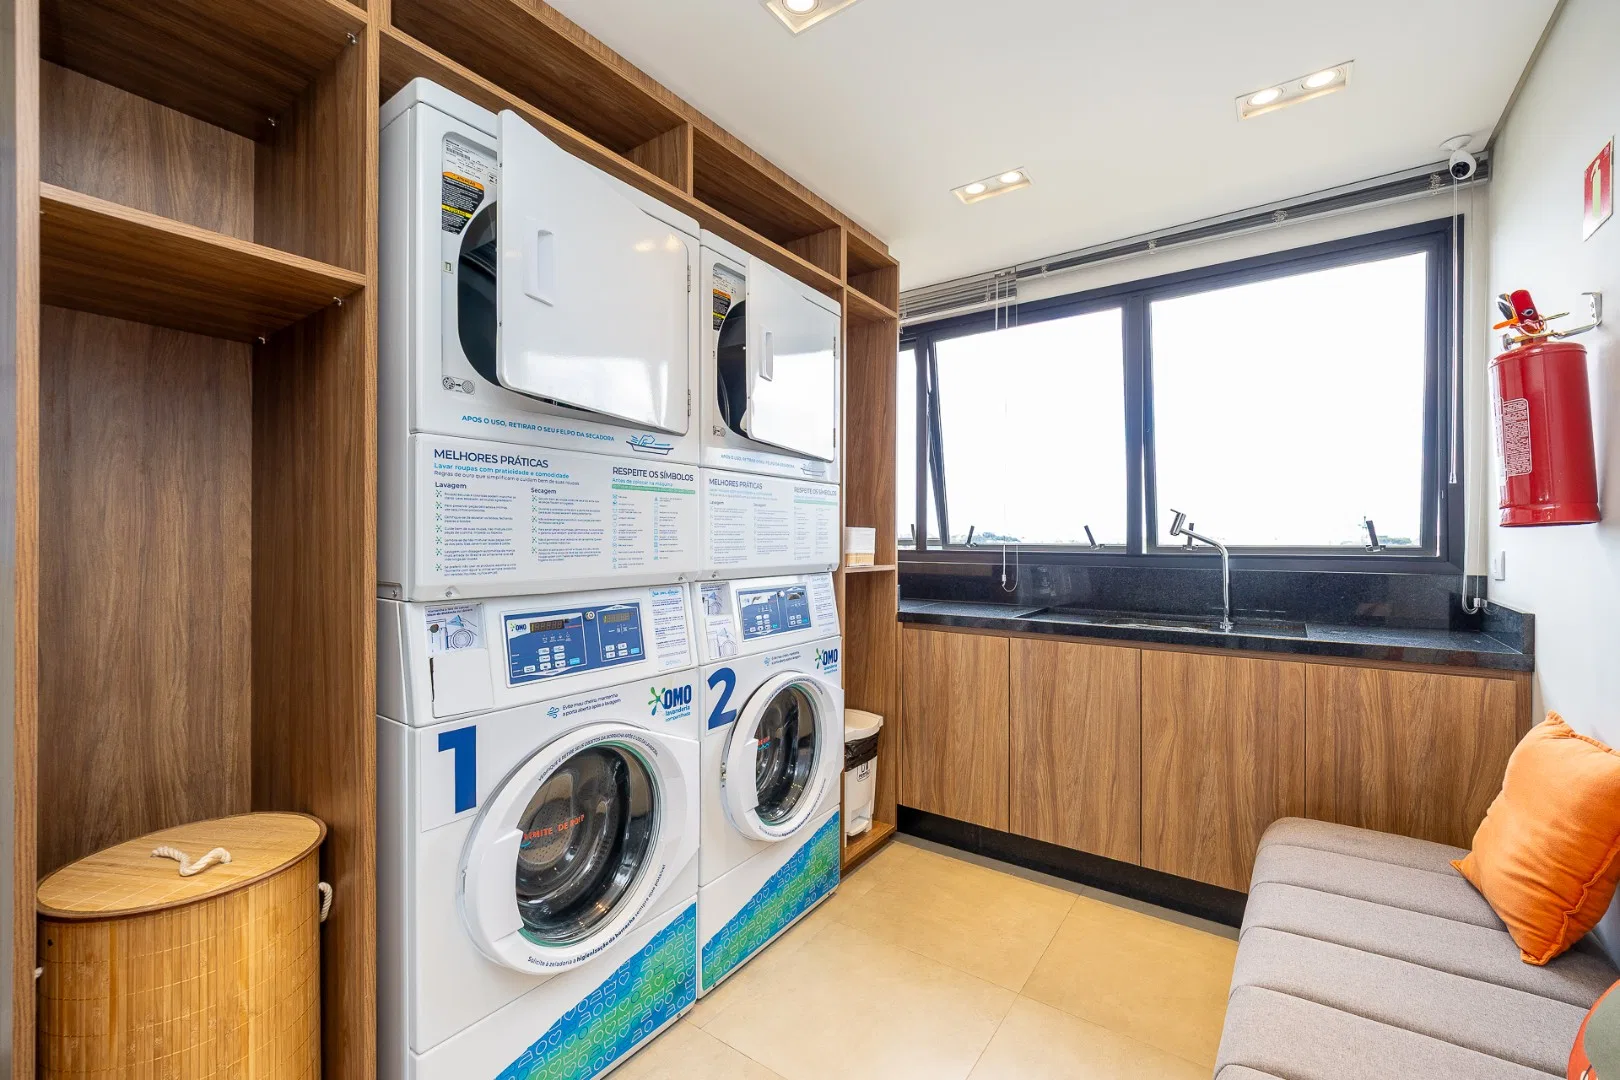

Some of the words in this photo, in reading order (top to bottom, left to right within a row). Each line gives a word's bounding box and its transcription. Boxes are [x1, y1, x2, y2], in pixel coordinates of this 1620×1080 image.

[491, 419, 507, 427] USO,
[508, 422, 536, 431] RETIRAR
[586, 432, 614, 441] SECADORA
[434, 449, 498, 463] MELHORES
[501, 455, 548, 468] PRÁTICAS
[495, 468, 529, 476] praticidade
[612, 467, 647, 478] RESPEITE
[660, 470, 694, 481] SÍMBOLOS
[709, 479, 739, 487] MELHORES
[740, 481, 762, 489] PRÁTICAS
[822, 649, 838, 665] OMO
[664, 684, 692, 710] OMO
[708, 668, 737, 730] 2
[666, 705, 690, 716] lavanderia
[438, 725, 476, 814] 1
[558, 822, 568, 831] DE
[528, 956, 545, 966] Solicite
[615, 917, 635, 938] borracha
